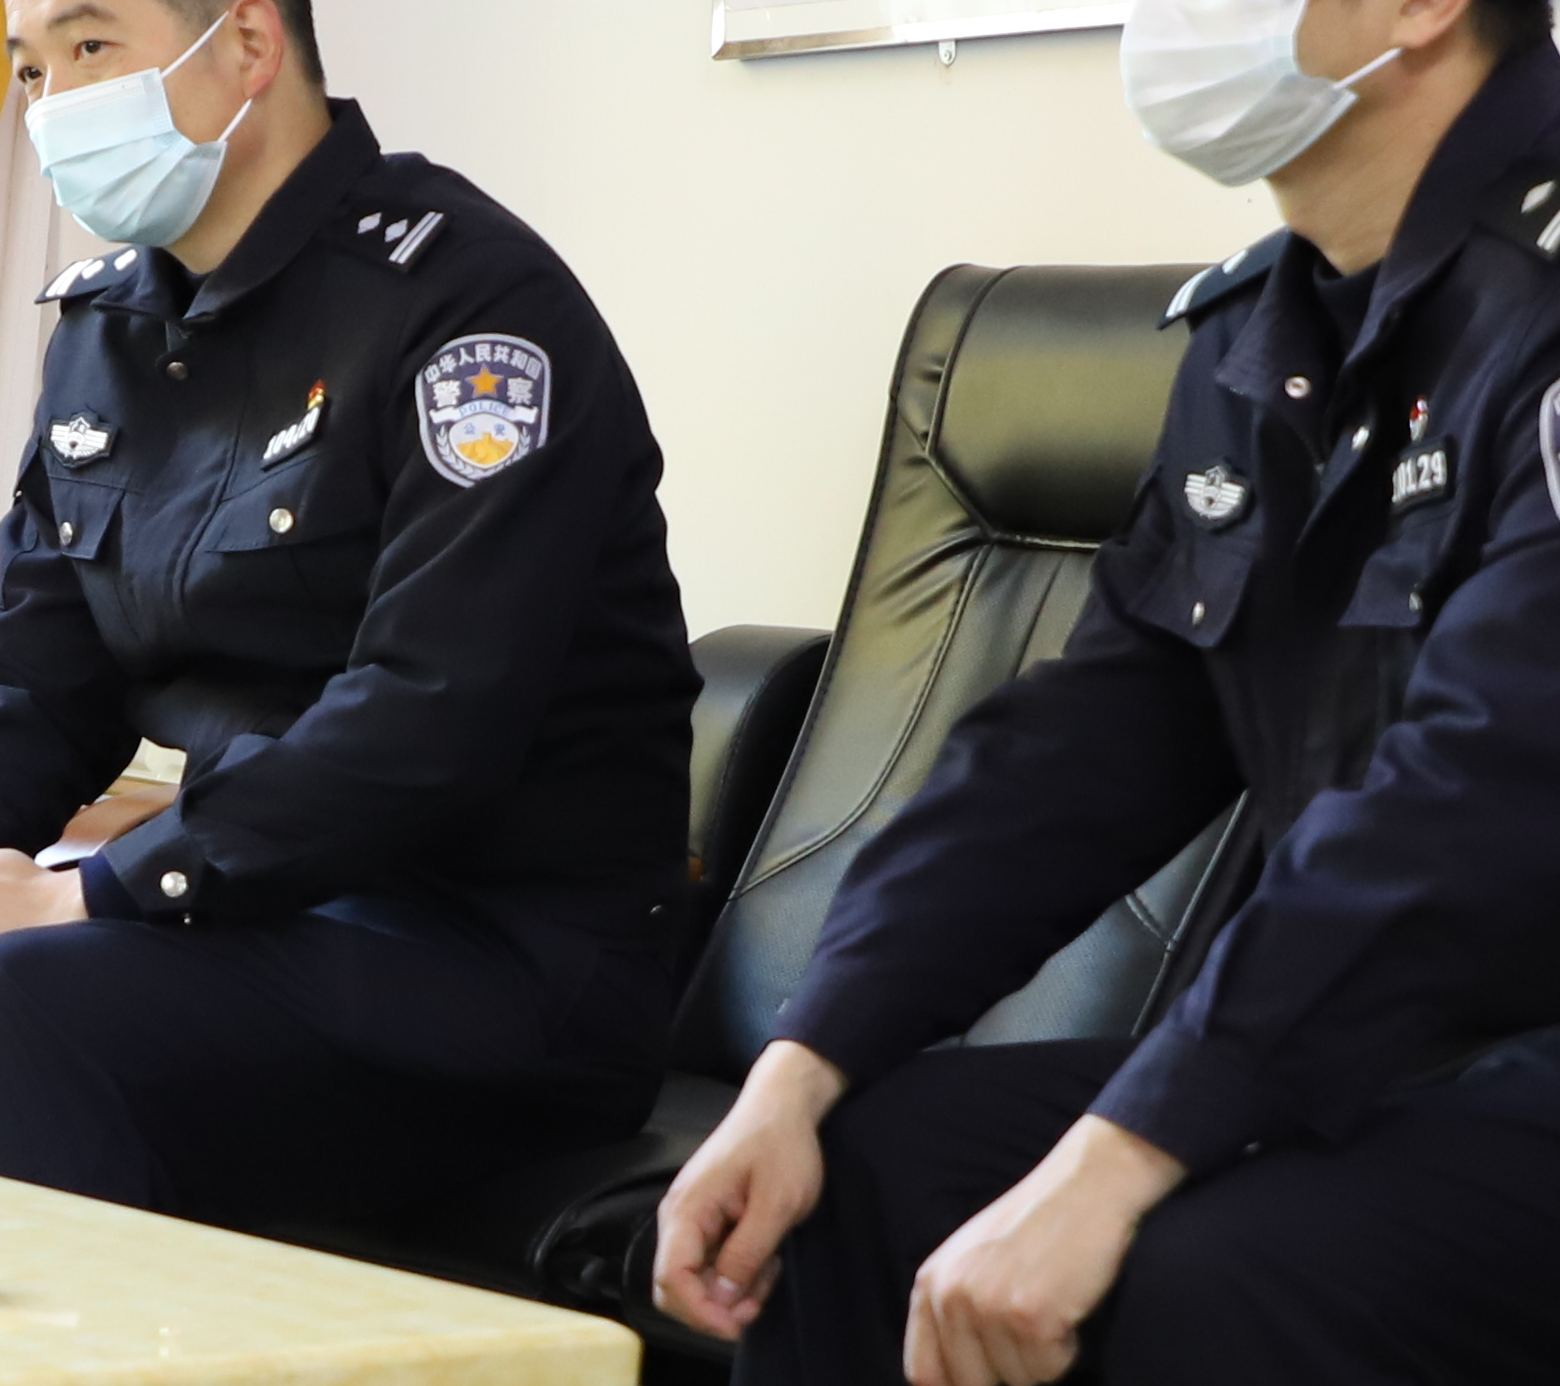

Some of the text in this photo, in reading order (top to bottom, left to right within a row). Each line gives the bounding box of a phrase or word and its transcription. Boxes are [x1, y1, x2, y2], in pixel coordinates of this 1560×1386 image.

[424, 343, 543, 384] 中华人民共和国
